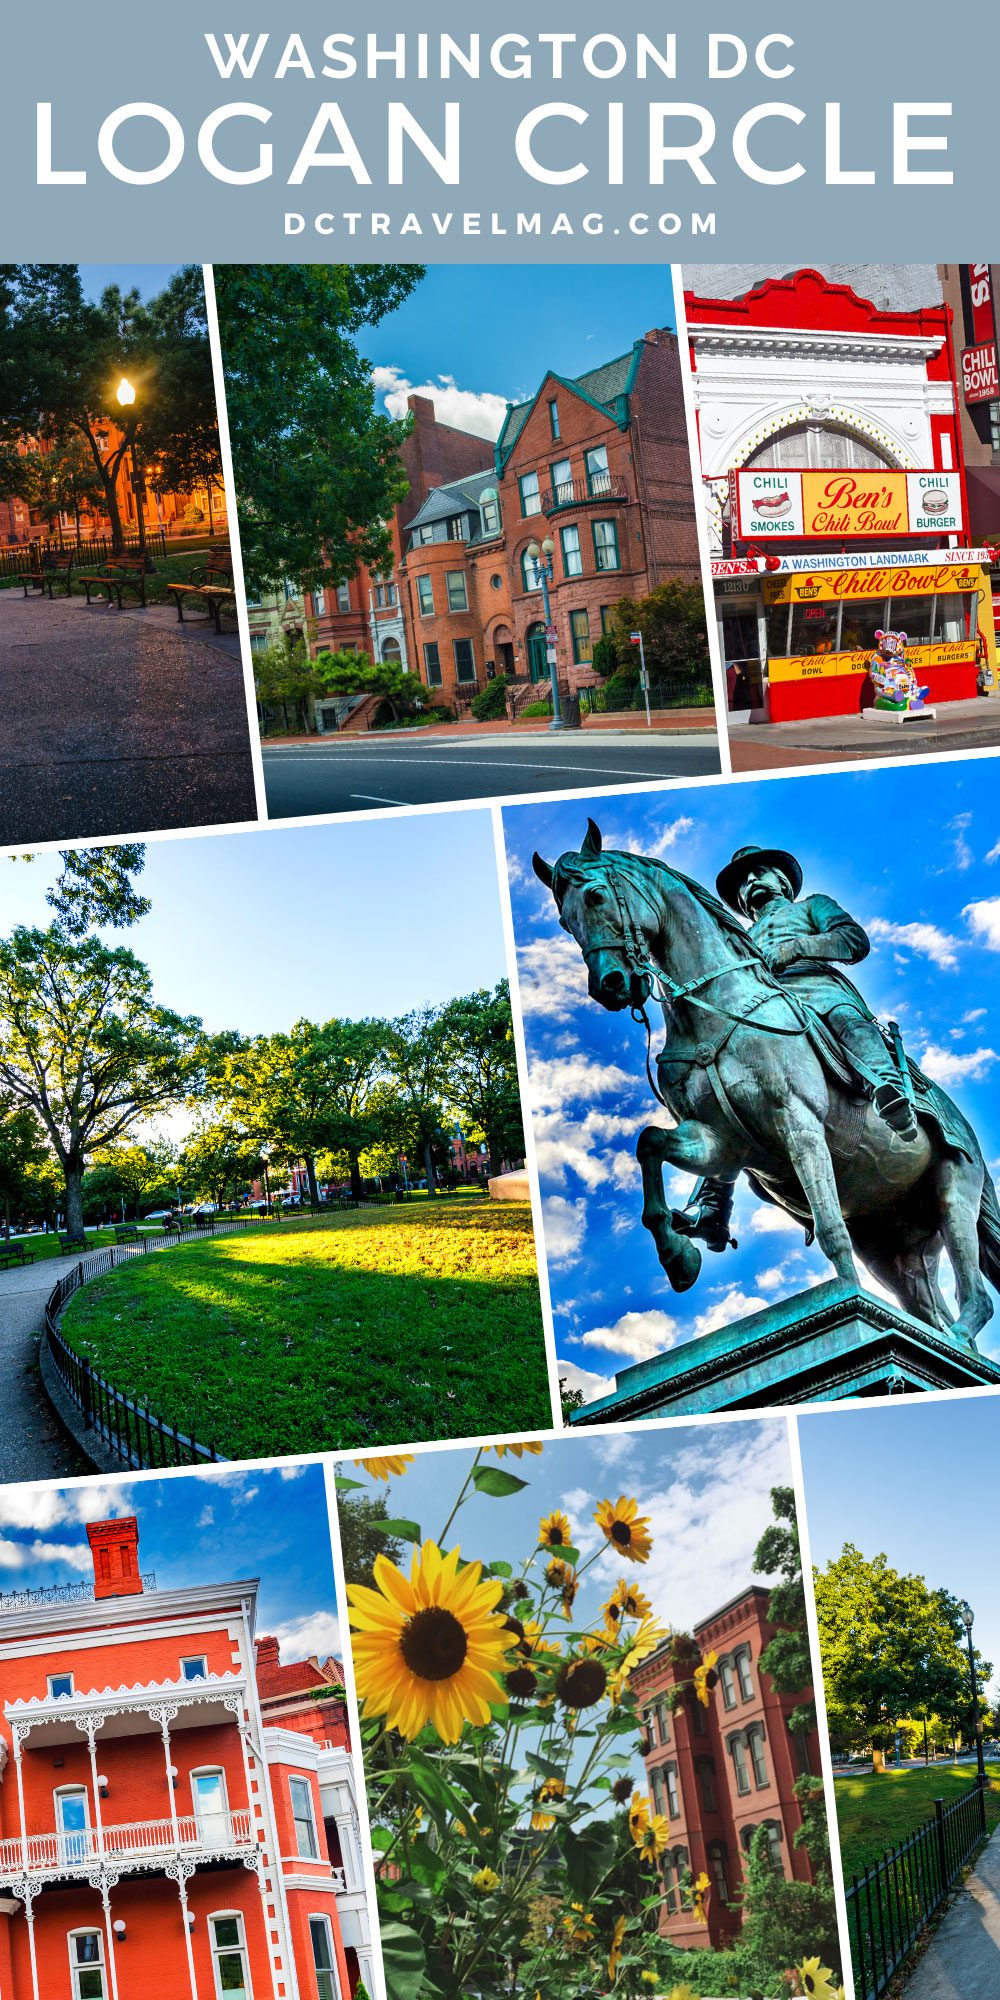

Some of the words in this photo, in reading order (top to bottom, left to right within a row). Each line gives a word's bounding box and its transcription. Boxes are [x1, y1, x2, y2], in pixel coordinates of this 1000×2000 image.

[962, 347, 996, 373] CHILI
[964, 368, 999, 392] BOWL
[753, 477, 788, 489] CHILI
[919, 477, 949, 488] CHILI
[817, 477, 893, 509] Ben's
[750, 521, 795, 532] SMOKES
[811, 512, 851, 533] Chili
[853, 510, 902, 532] Bowl
[916, 517, 956, 528] BURGER
[781, 560, 789, 570] A
[792, 555, 867, 569] WASHINGTON
[870, 553, 929, 566] LANDMARK
[944, 551, 975, 562] SINCE
[833, 570, 888, 595] Chili
[891, 567, 950, 592] Bowl
[799, 587, 819, 597] BEN'S
[804, 608, 825, 619] OPEN
[943, 643, 966, 653] Chili
[801, 656, 826, 667] Chili
[937, 653, 969, 662] BURGERS
